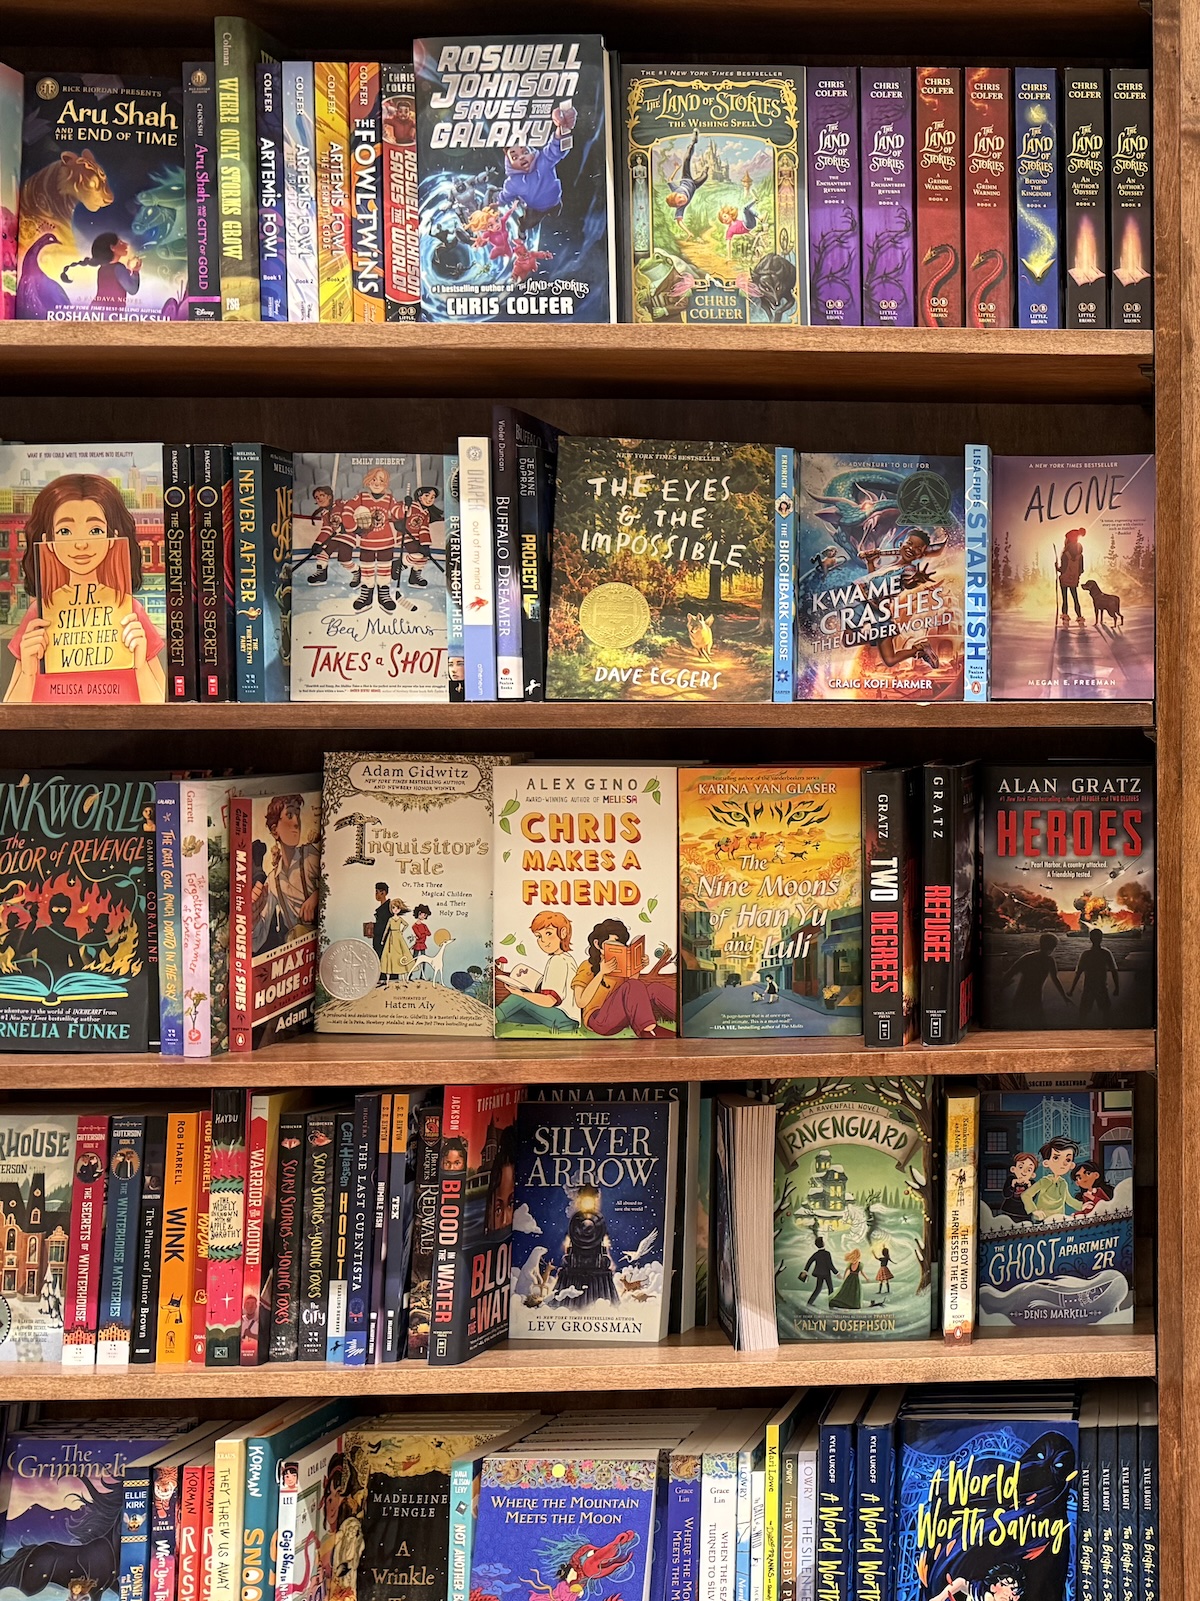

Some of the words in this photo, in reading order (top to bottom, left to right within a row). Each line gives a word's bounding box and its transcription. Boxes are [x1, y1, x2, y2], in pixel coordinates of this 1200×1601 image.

[437, 44, 581, 72] ROSWELL
[81, 86, 115, 95] RIORDAN
[117, 88, 162, 97] PRESENTS
[432, 68, 579, 109] JOHNSON
[56, 100, 110, 125] Aru
[113, 102, 179, 129] Shah
[453, 100, 529, 120] SAVES
[530, 102, 552, 118] THE
[689, 119, 728, 128] WISHING
[730, 119, 756, 128] SPELL
[446, 297, 500, 315] CHRIS
[507, 297, 573, 314] COLFER
[588, 474, 655, 499] THE
[662, 477, 730, 502] EYES
[1024, 474, 1125, 524] ALONE
[581, 530, 746, 568] IMPOSSIBLE
[967, 514, 985, 660] STARFISH
[58, 607, 113, 628] SILVER
[820, 588, 944, 635] CRASHES
[53, 632, 94, 645] WRITES
[97, 630, 118, 643] HER
[50, 684, 83, 694] MELISSA
[87, 683, 120, 694] DASSORI
[594, 667, 643, 685] DAVE
[651, 668, 722, 689] EGGERS
[829, 678, 860, 689] CRAIG
[864, 679, 888, 688] KOFI
[891, 679, 932, 689] FARMER
[362, 765, 404, 778] Adam
[408, 766, 468, 779] Gidwitz
[527, 778, 575, 790] ALEX
[585, 778, 638, 790] GINO
[698, 783, 747, 795] KARINA
[750, 783, 782, 795] YAN
[785, 783, 836, 794] GLASER
[997, 810, 1142, 857] HEROES
[522, 880, 642, 905] FRIEND
[697, 876, 750, 897] Nine
[758, 876, 838, 898] Moons
[385, 1000, 413, 1010] Hatem
[417, 1000, 435, 1010] Aly
[67, 1024, 130, 1039] FUNKE
[216, 1114, 238, 1124] HAYDU
[77, 1133, 105, 1142] GUTERSON
[534, 1126, 652, 1158] SILVER
[783, 1116, 909, 1152] RAVENGUARD
[525, 1158, 659, 1189] ARROW
[164, 1208, 188, 1263] WINK
[337, 1192, 349, 1279] HOOT
[1024, 1309, 1047, 1319] DENIS
[1050, 1307, 1088, 1319] MARKELL
[528, 1322, 554, 1332] LEV
[561, 1322, 642, 1334] GROSSMAN
[247, 1446, 263, 1497] KORMAN
[929, 1469, 944, 1502] A
[948, 1455, 1021, 1510] World
[373, 1493, 448, 1504] MADELEINE
[491, 1496, 538, 1509] WHERE
[543, 1497, 566, 1508] THE
[568, 1497, 639, 1509] MOUNTAIN
[917, 1498, 986, 1551] Worth
[989, 1508, 1071, 1554] Saving
[371, 1568, 435, 1586] Wrinkle
